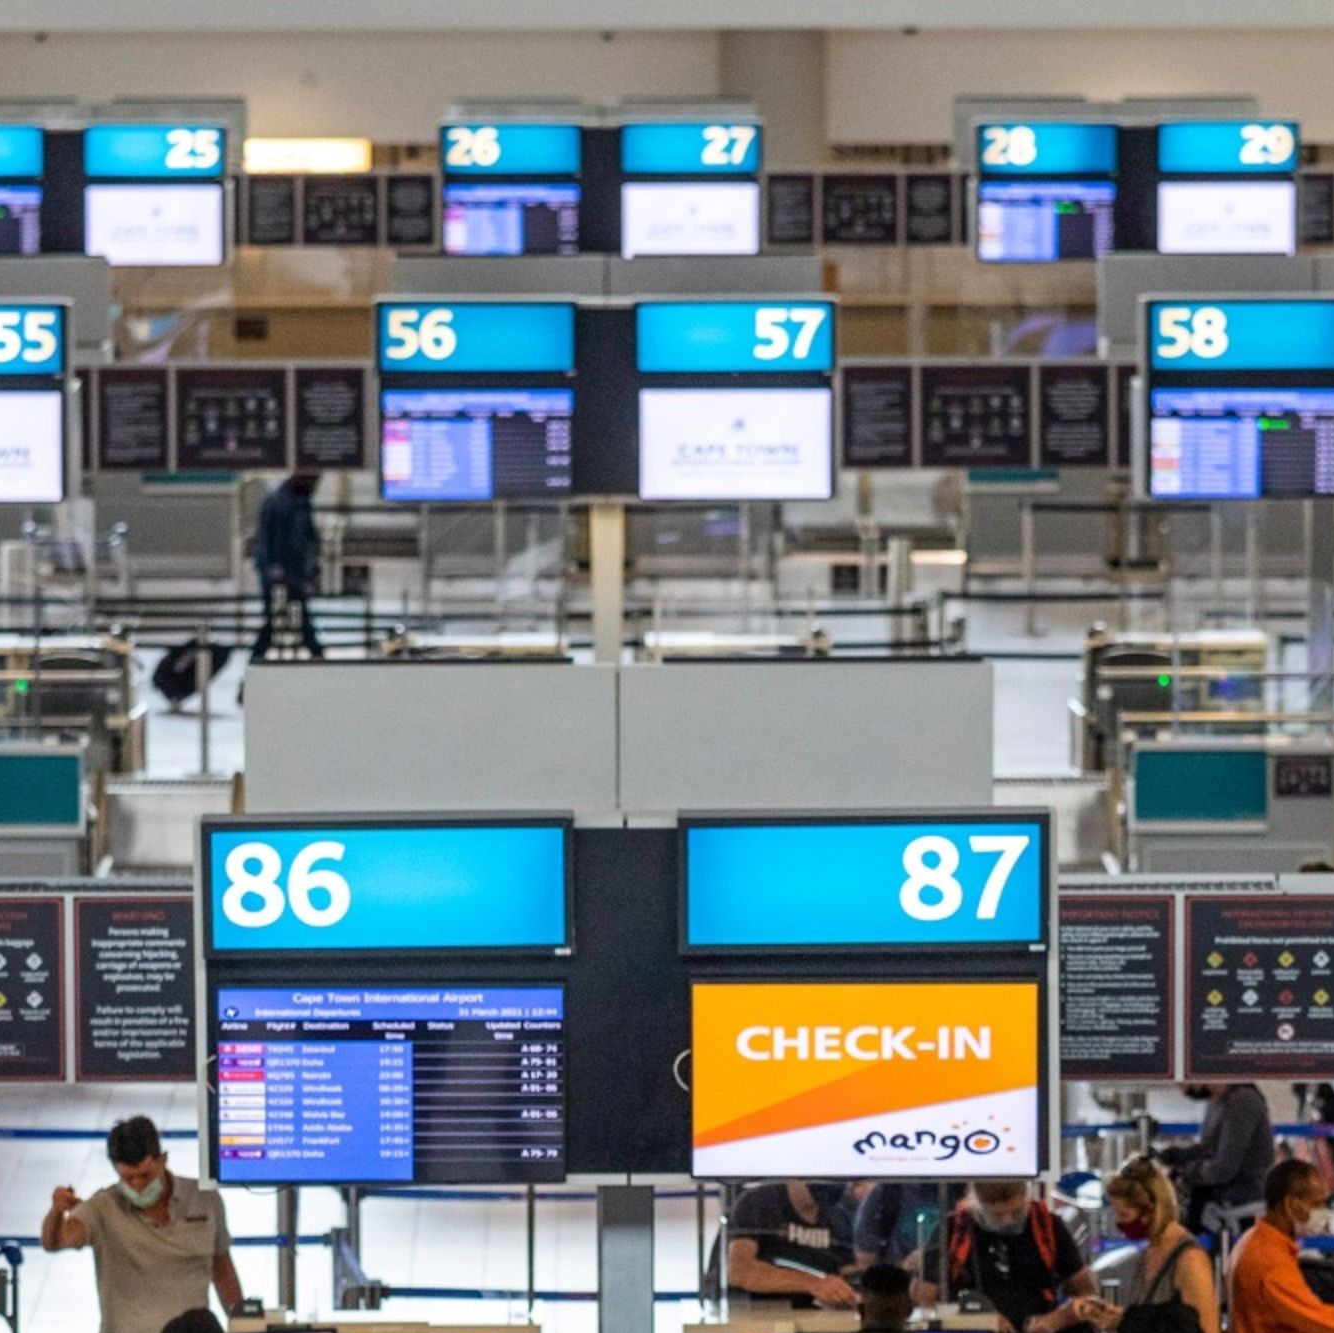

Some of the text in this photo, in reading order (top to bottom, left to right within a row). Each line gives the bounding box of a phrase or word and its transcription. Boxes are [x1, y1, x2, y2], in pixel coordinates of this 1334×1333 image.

[166, 129, 219, 168] 25
[447, 127, 500, 165] 26
[702, 126, 754, 164] 27
[984, 127, 1036, 165] 28
[1240, 125, 1294, 163] 29
[387, 310, 456, 359] 56
[754, 309, 825, 359] 57
[1158, 308, 1227, 357] 58
[224, 842, 350, 926] 86
[901, 836, 1028, 920] 87
[293, 993, 483, 1005] Cape Town International Airport
[735, 1027, 992, 1062] CHECK-IN
[852, 1129, 1001, 1162] mango
